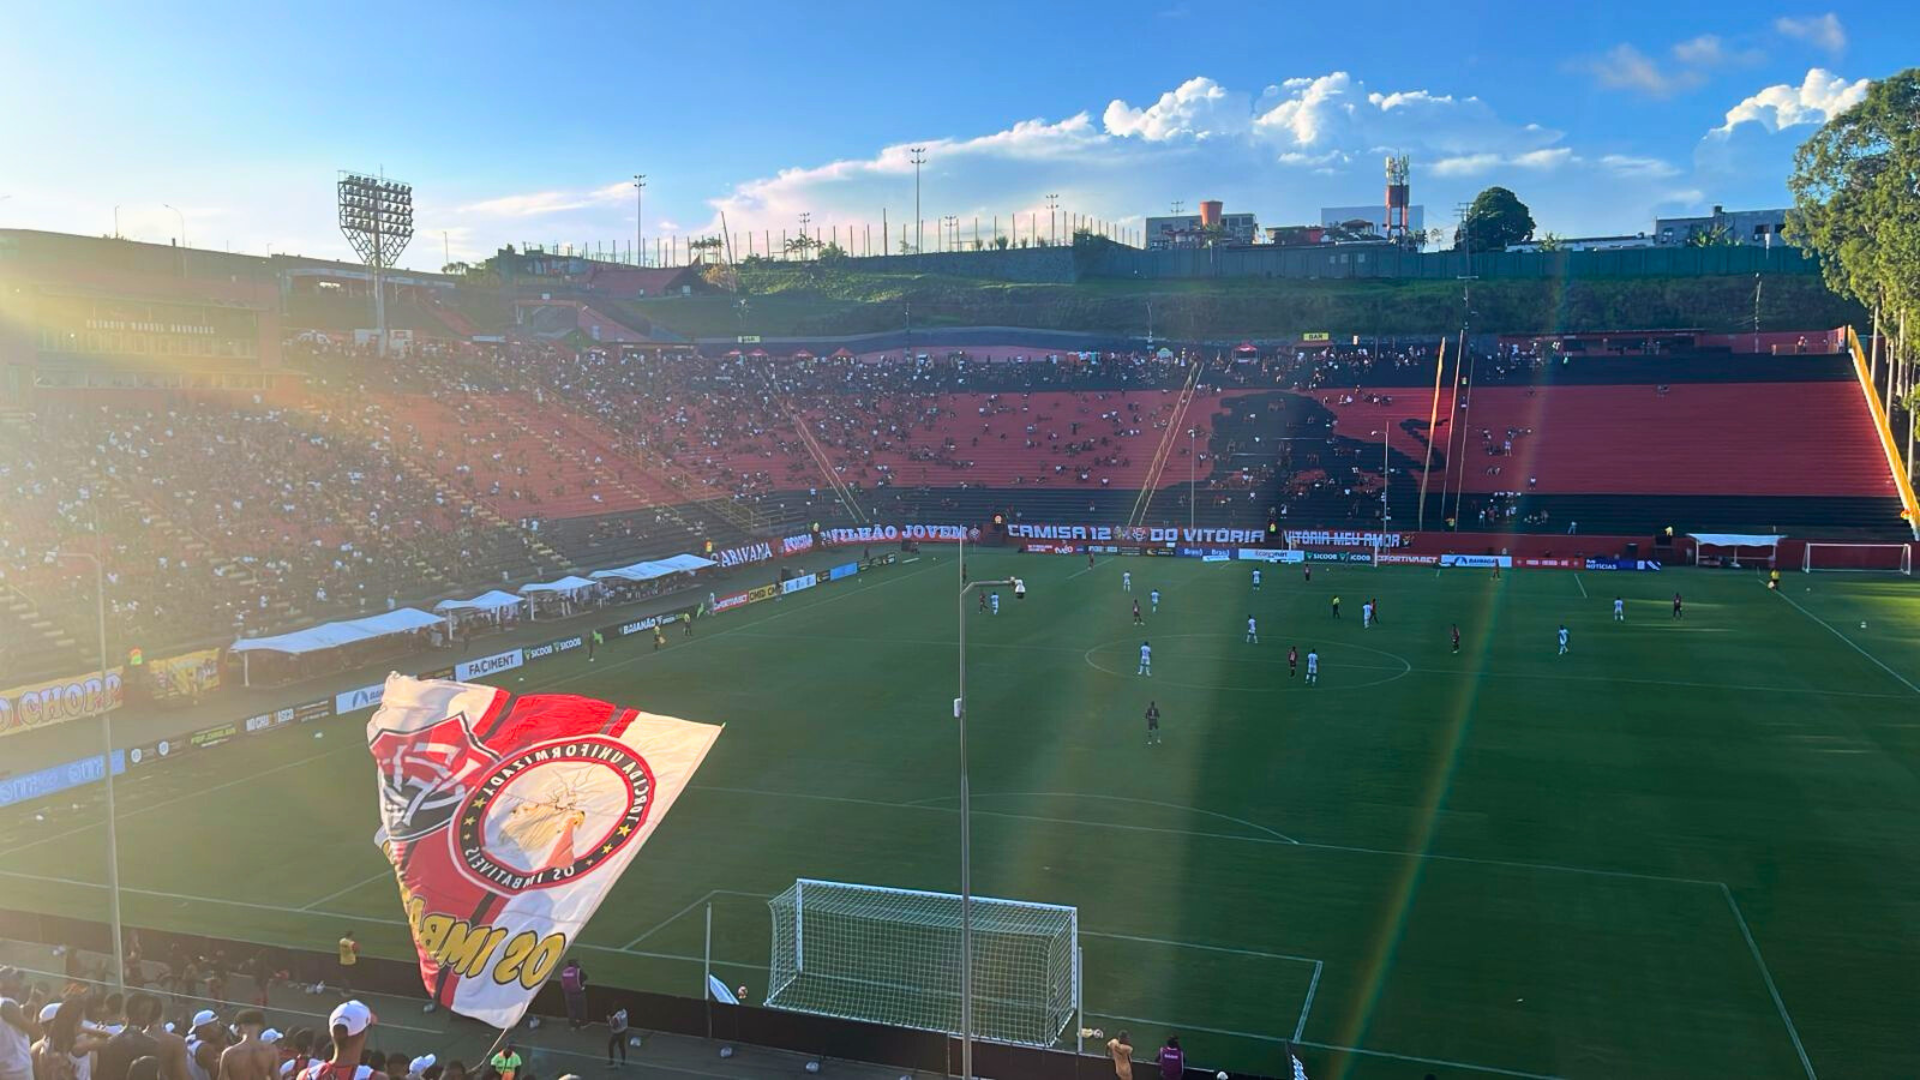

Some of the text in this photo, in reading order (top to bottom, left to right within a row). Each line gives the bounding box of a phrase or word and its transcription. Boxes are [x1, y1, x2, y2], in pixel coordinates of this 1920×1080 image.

[901, 525, 968, 541] JOVEM
[1007, 524, 1112, 541] CAMISA 12
[1150, 528, 1178, 542] DO
[1334, 532, 1360, 546] MEU
[1363, 533, 1400, 548] AMOR
[468, 654, 515, 676] FACIMENT
